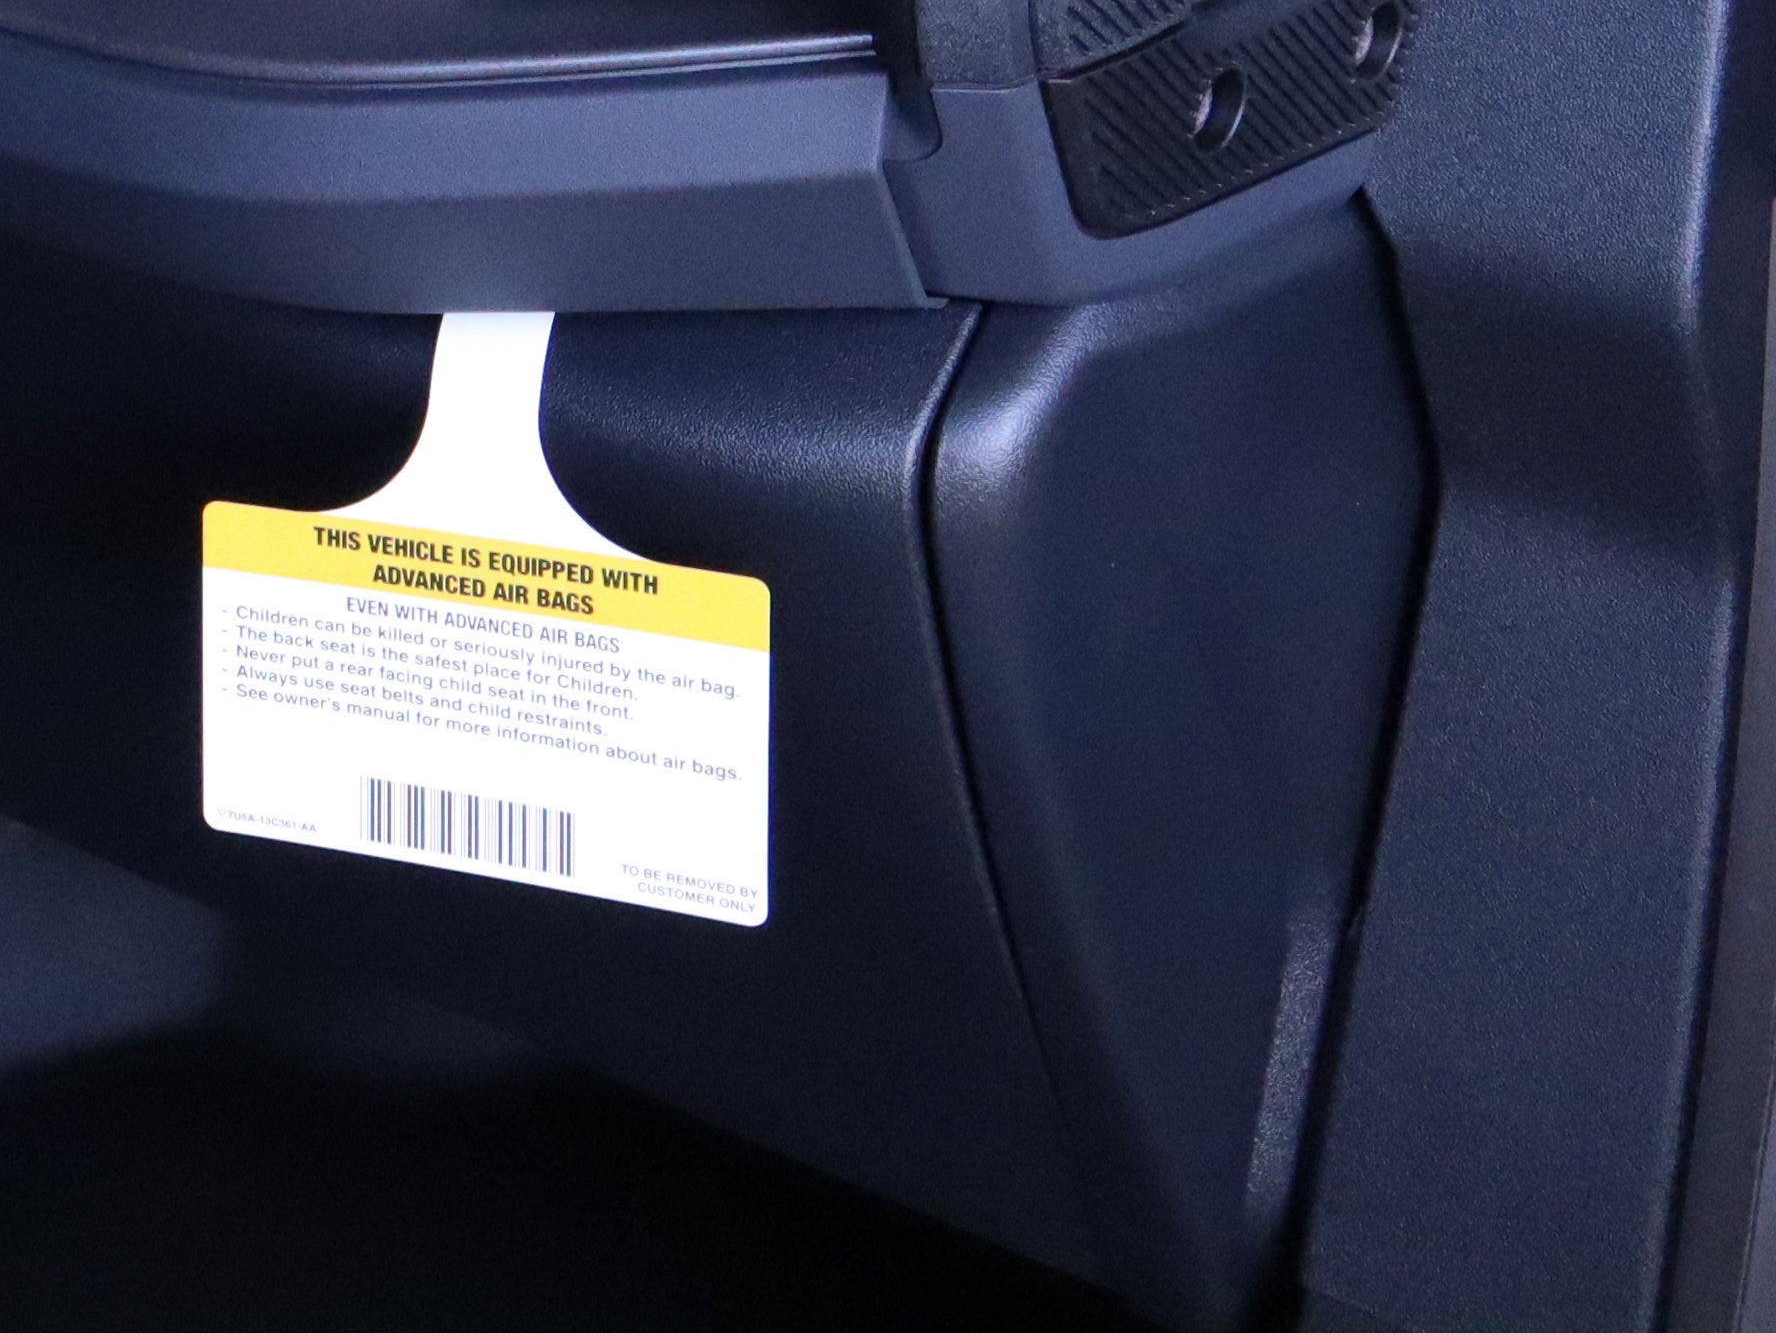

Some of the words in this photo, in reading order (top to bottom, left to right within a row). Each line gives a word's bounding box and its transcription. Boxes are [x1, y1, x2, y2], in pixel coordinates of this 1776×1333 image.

[313, 526, 360, 550] THIS
[367, 534, 452, 564] VEHICLE
[461, 548, 480, 567] IS
[488, 552, 593, 584] EQUIPPED
[601, 569, 657, 594] WITH
[372, 564, 485, 597] ADVANCED
[493, 583, 528, 604] AIR
[536, 589, 593, 614] BAGS
[236, 605, 308, 627] Children
[314, 619, 344, 632] can
[351, 622, 371, 637] be
[378, 626, 423, 644] killed
[429, 636, 447, 655] or
[454, 640, 534, 670] seriously
[541, 653, 603, 675] injured
[610, 663, 630, 681] by
[637, 668, 665, 684] the
[671, 675, 694, 688] air
[346, 596, 388, 616] EVEN
[394, 604, 437, 623] WITH
[444, 612, 532, 638] ADVANCED
[539, 627, 567, 643] AIR
[574, 632, 619, 653] BAGS
[236, 624, 267, 641] The
[273, 630, 313, 648] back
[320, 639, 354, 654] seat
[361, 644, 375, 657] is
[381, 647, 408, 662] the
[415, 654, 466, 671] safest
[473, 663, 520, 680] place
[526, 670, 550, 684] for
[236, 644, 285, 663] Never
[291, 655, 318, 668] put
[324, 660, 333, 671] a
[340, 663, 373, 677] rear
[379, 666, 432, 690] facing
[438, 678, 481, 694] child
[488, 686, 523, 701] seat
[531, 692, 545, 704] in
[552, 695, 579, 710] the
[236, 664, 297, 687] Always
[304, 677, 334, 690] use
[340, 682, 375, 697] seat
[381, 686, 423, 704] belts
[429, 696, 461, 711] and
[467, 703, 510, 719] child
[236, 683, 267, 700] See
[273, 692, 340, 711] owner's
[346, 703, 409, 722] manual
[416, 712, 439, 726] for
[446, 719, 490, 735] more
[497, 726, 599, 754] information
[605, 746, 656, 764] about
[663, 756, 685, 769] air
[621, 864, 639, 876] TO
[644, 868, 662, 881] BE
[666, 872, 736, 895] REMOVED
[740, 886, 758, 899] BY
[637, 881, 715, 905] CUSTOMER
[719, 897, 757, 913] ONLY
